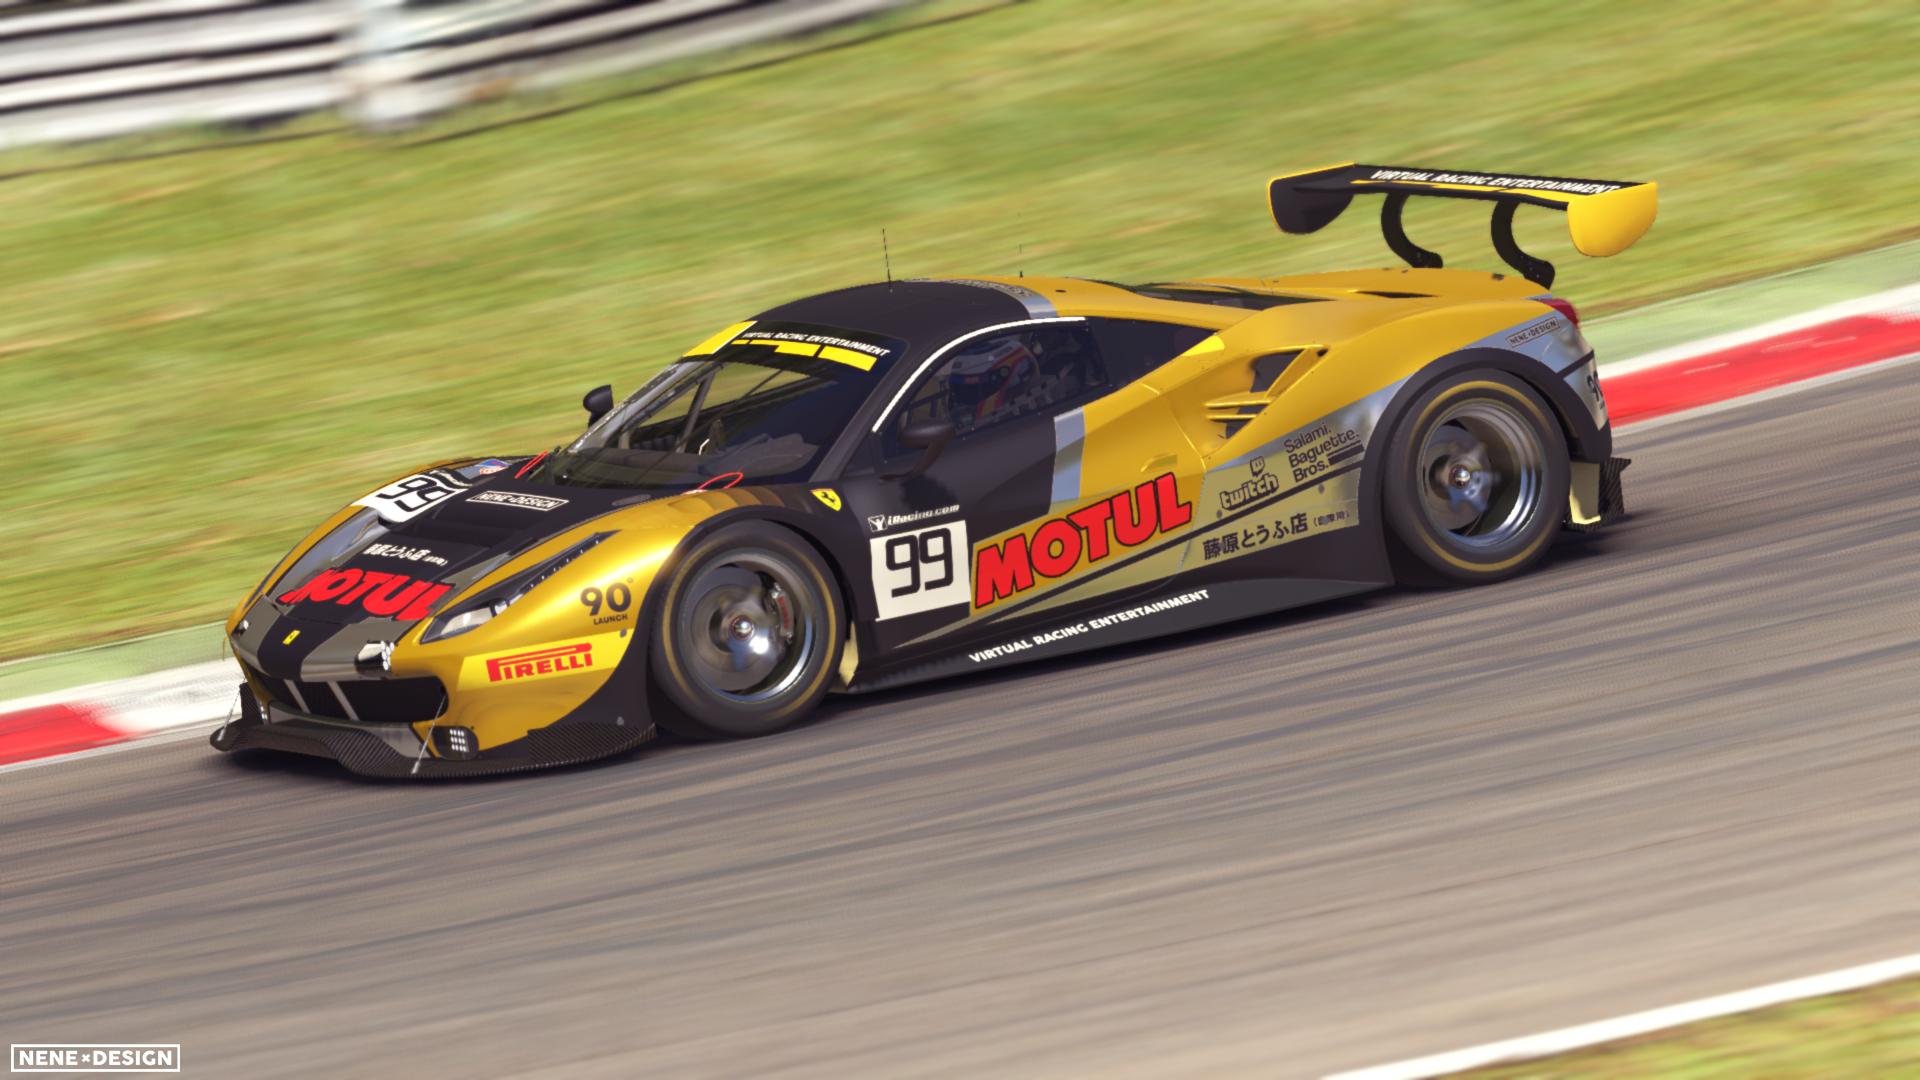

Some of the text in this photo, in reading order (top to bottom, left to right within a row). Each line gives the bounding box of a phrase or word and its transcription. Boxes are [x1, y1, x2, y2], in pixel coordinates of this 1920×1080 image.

[1370, 170, 1620, 194] VIRTUAL RACING ENTERTAINMENT
[773, 332, 808, 341] RACING
[805, 334, 891, 357] ENTERTAINMENT
[1284, 423, 1331, 453] Salami.
[1288, 428, 1360, 468] Baguette.
[1292, 460, 1329, 483] Bros.
[376, 477, 456, 512] 99
[1219, 472, 1279, 511] twitch
[888, 504, 960, 525] iRacing.com
[975, 471, 1192, 610] MOTUL
[886, 527, 954, 598] 99
[593, 614, 628, 625] LAUNCH
[968, 589, 1210, 663] VIRTUAL RACING ENTERTAINMENT
[486, 642, 593, 682] PIRELLI
